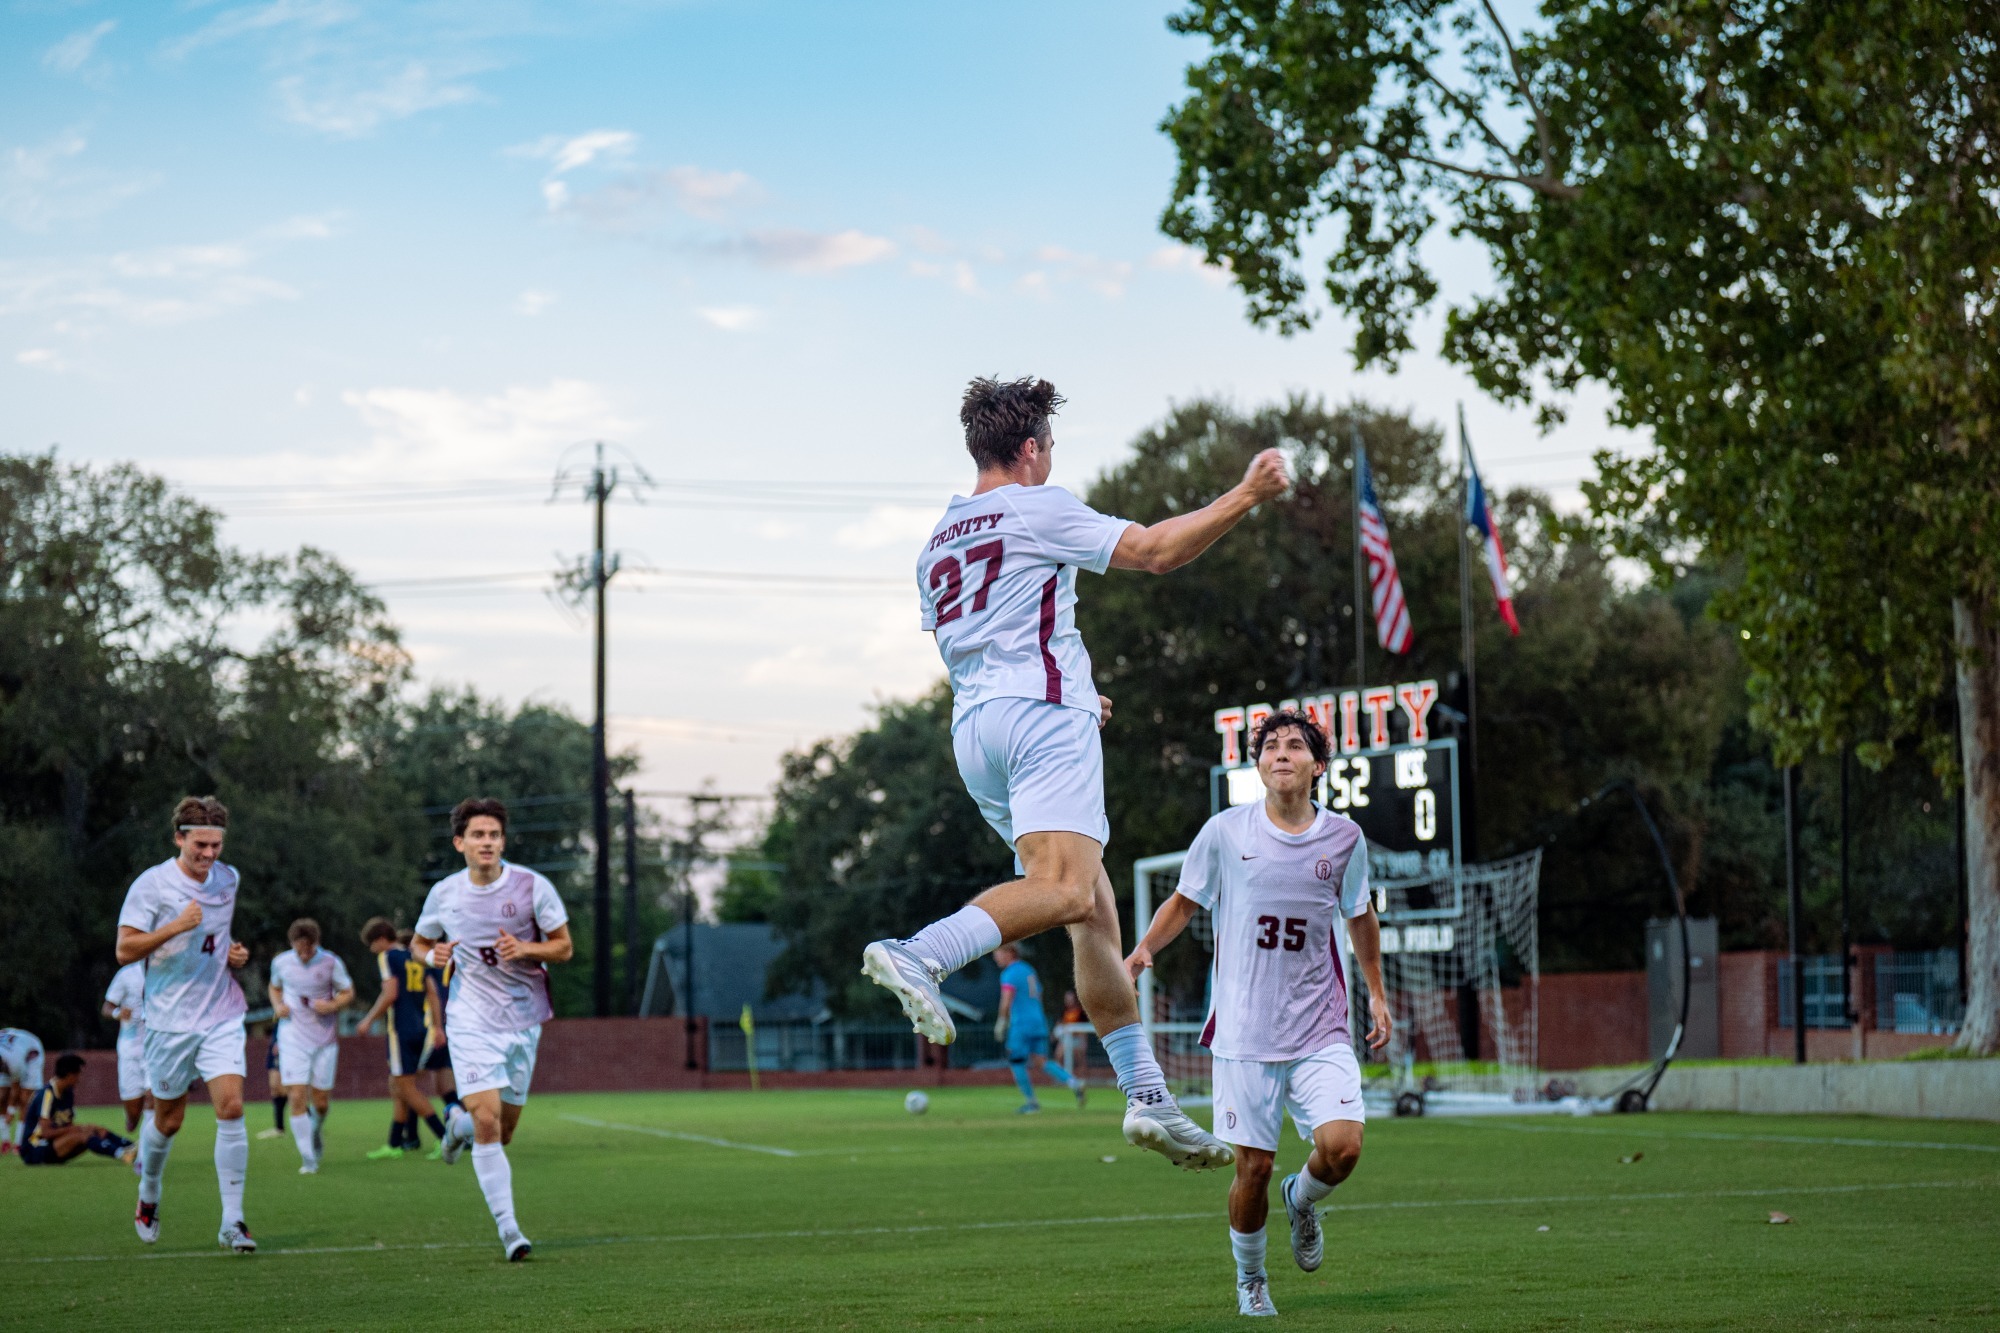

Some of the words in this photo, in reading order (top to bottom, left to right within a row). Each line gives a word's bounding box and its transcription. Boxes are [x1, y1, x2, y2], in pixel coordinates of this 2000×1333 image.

[929, 512, 1004, 552] TRINITY
[929, 538, 1004, 628] 27
[1415, 789, 1436, 841] 0
[201, 935, 216, 956] 4
[1257, 915, 1307, 951] 35
[480, 947, 498, 967] 8
[404, 960, 425, 993] 12
